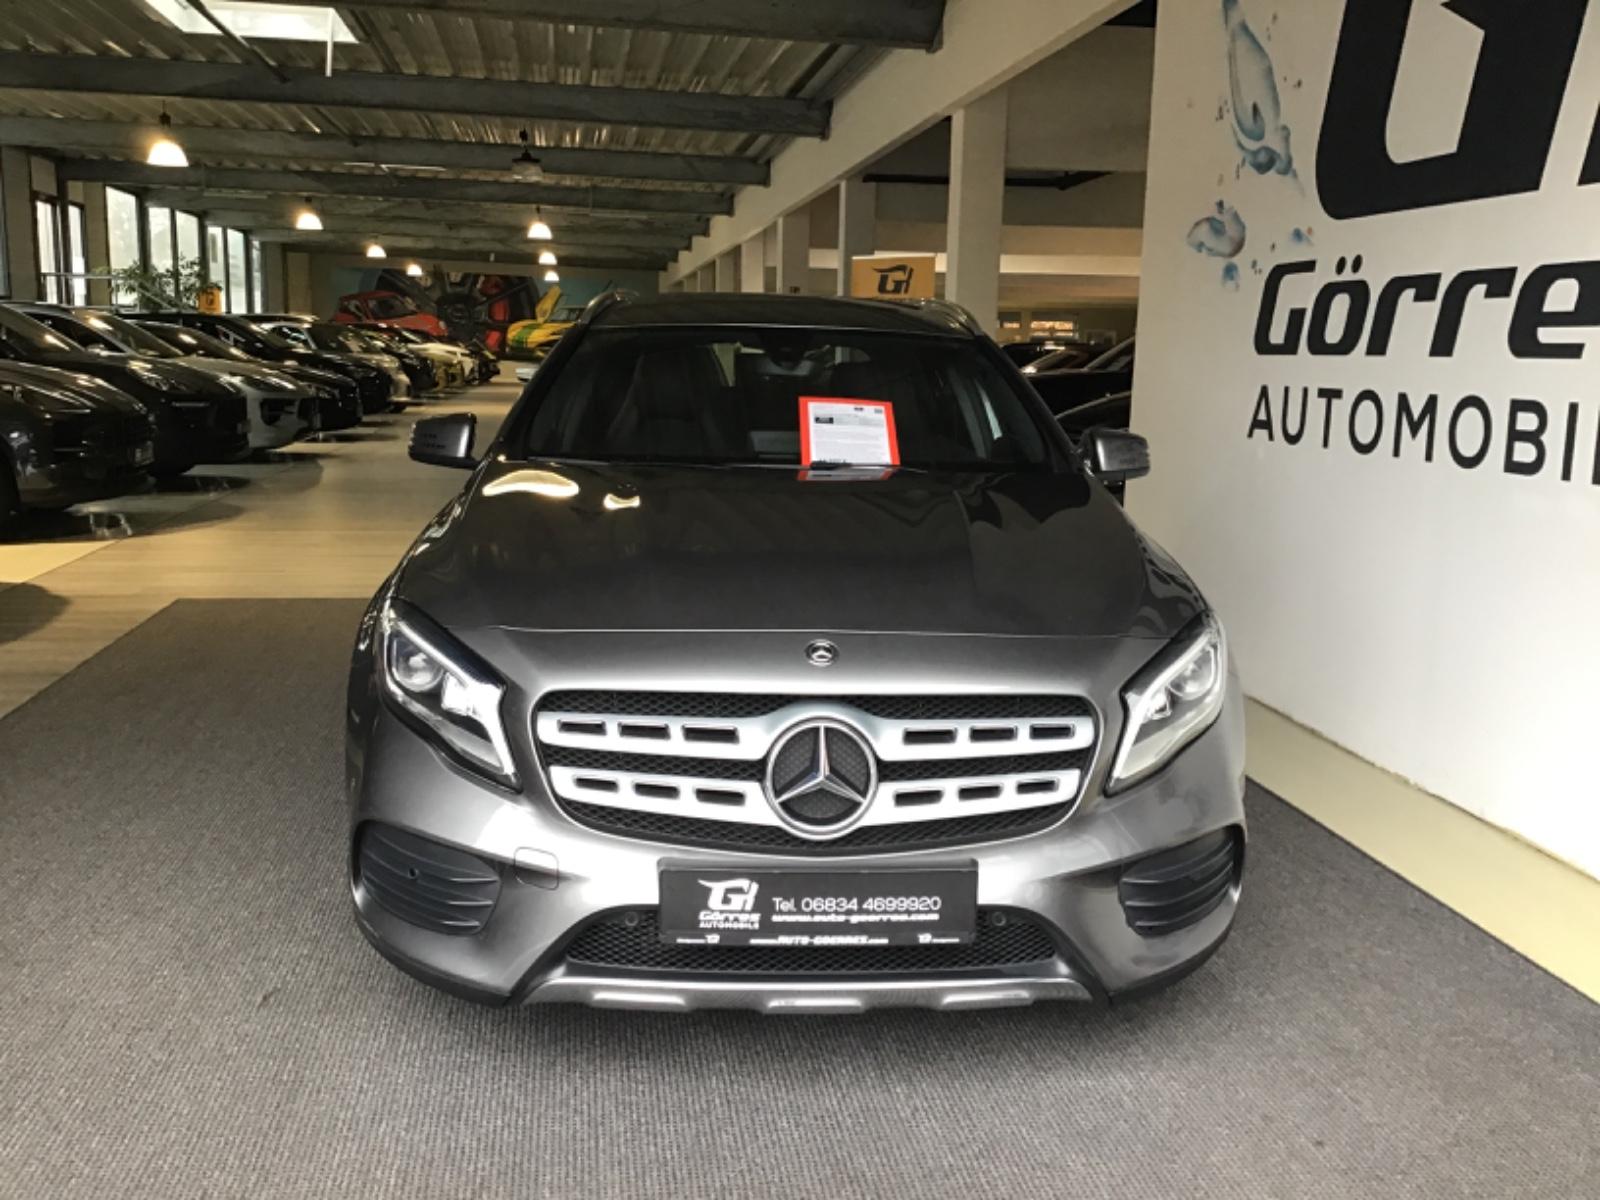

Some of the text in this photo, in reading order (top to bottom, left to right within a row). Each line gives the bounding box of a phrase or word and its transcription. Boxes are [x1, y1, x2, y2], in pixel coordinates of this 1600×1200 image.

[1247, 384, 1600, 486] AUTOMOBI
[772, 896, 942, 912] Tel. 06834 4699920
